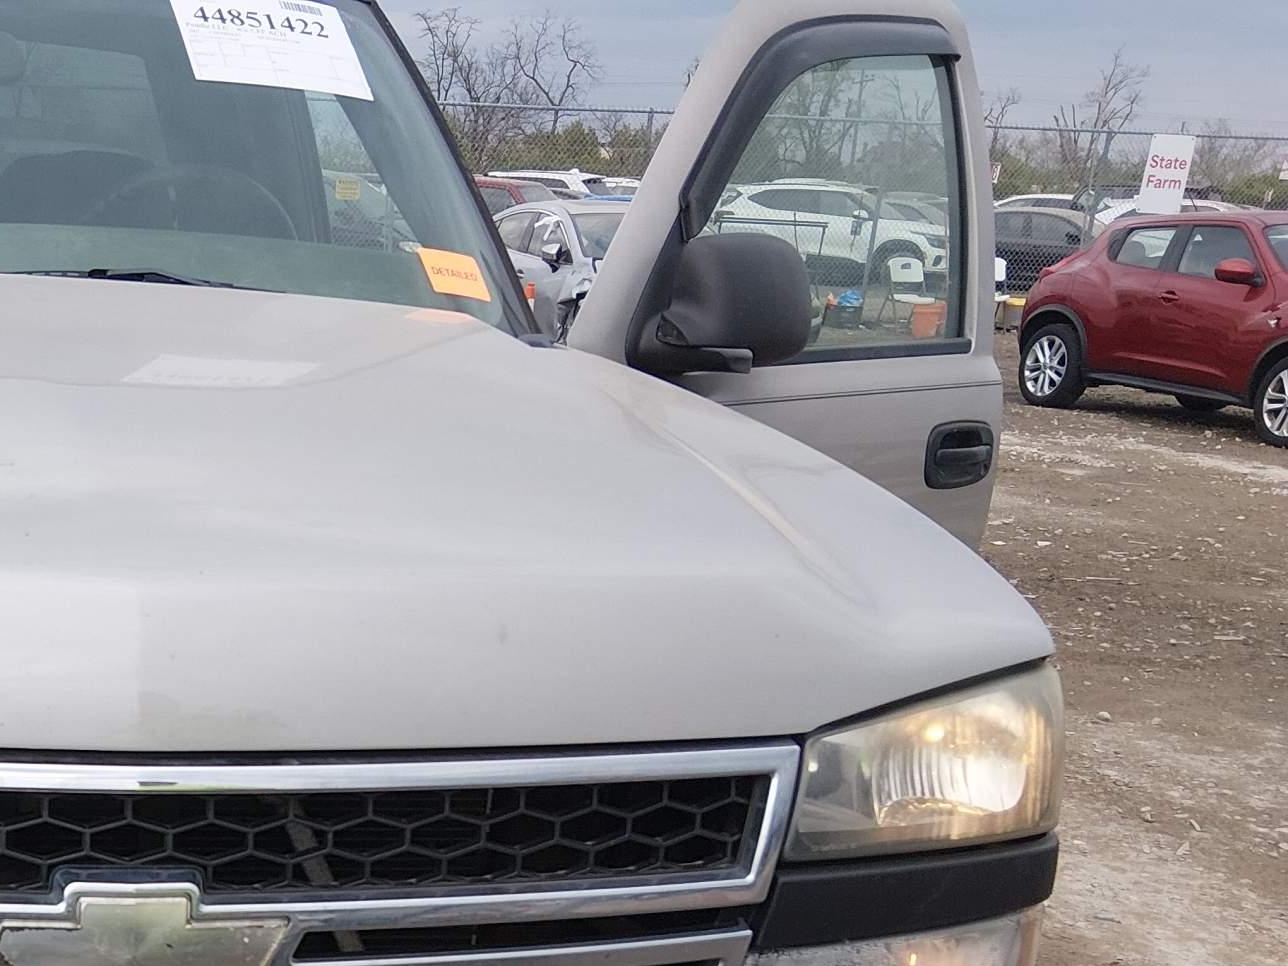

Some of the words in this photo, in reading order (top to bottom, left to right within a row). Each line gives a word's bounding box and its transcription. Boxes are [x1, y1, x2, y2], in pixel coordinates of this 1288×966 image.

[192, 6, 329, 39] 44851422
[1149, 154, 1188, 170] State
[1146, 174, 1182, 190] Farm
[431, 266, 478, 282] DETAILED
